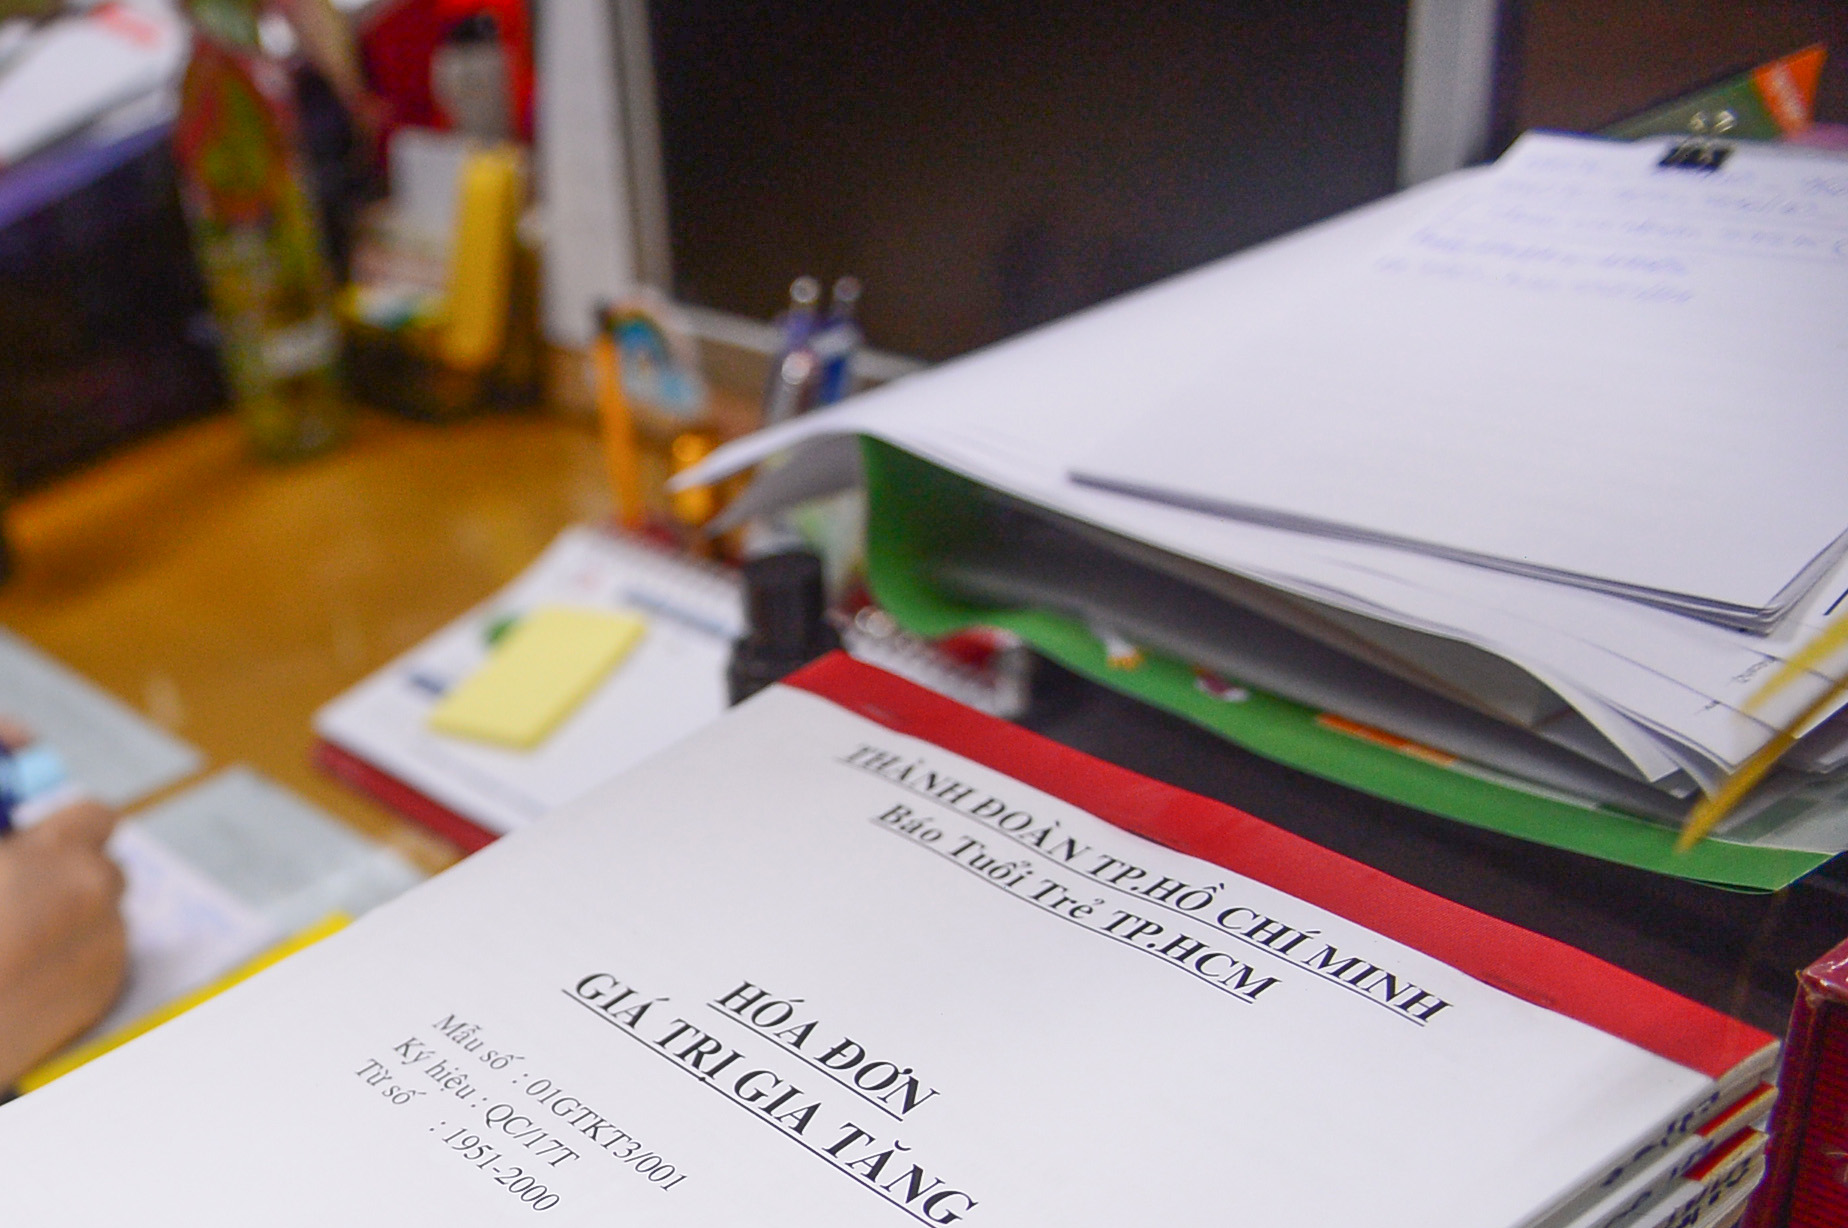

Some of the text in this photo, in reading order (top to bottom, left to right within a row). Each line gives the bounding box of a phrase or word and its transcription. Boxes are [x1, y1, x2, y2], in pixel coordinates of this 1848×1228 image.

[846, 743, 1454, 1024] THÀNH ĐOÀN TP.HỒ CHÍ MINH
[877, 803, 1283, 1001] Báo Tuổi Trẻ TP.HCM
[355, 1058, 393, 1087] Từ
[381, 1084, 427, 1106] số
[442, 1127, 561, 1212] 1951-2000
[392, 1036, 436, 1066] Ký
[424, 1058, 477, 1100] hiệu
[485, 1102, 581, 1168] QC/17T
[431, 1013, 484, 1053] Mẫu
[479, 1046, 525, 1071] số
[525, 1078, 688, 1192] 01GTKT3/001
[575, 972, 979, 1227] GIÁ TRỊ GIA TĂNG
[714, 979, 941, 1115] HÓA ĐƠN
